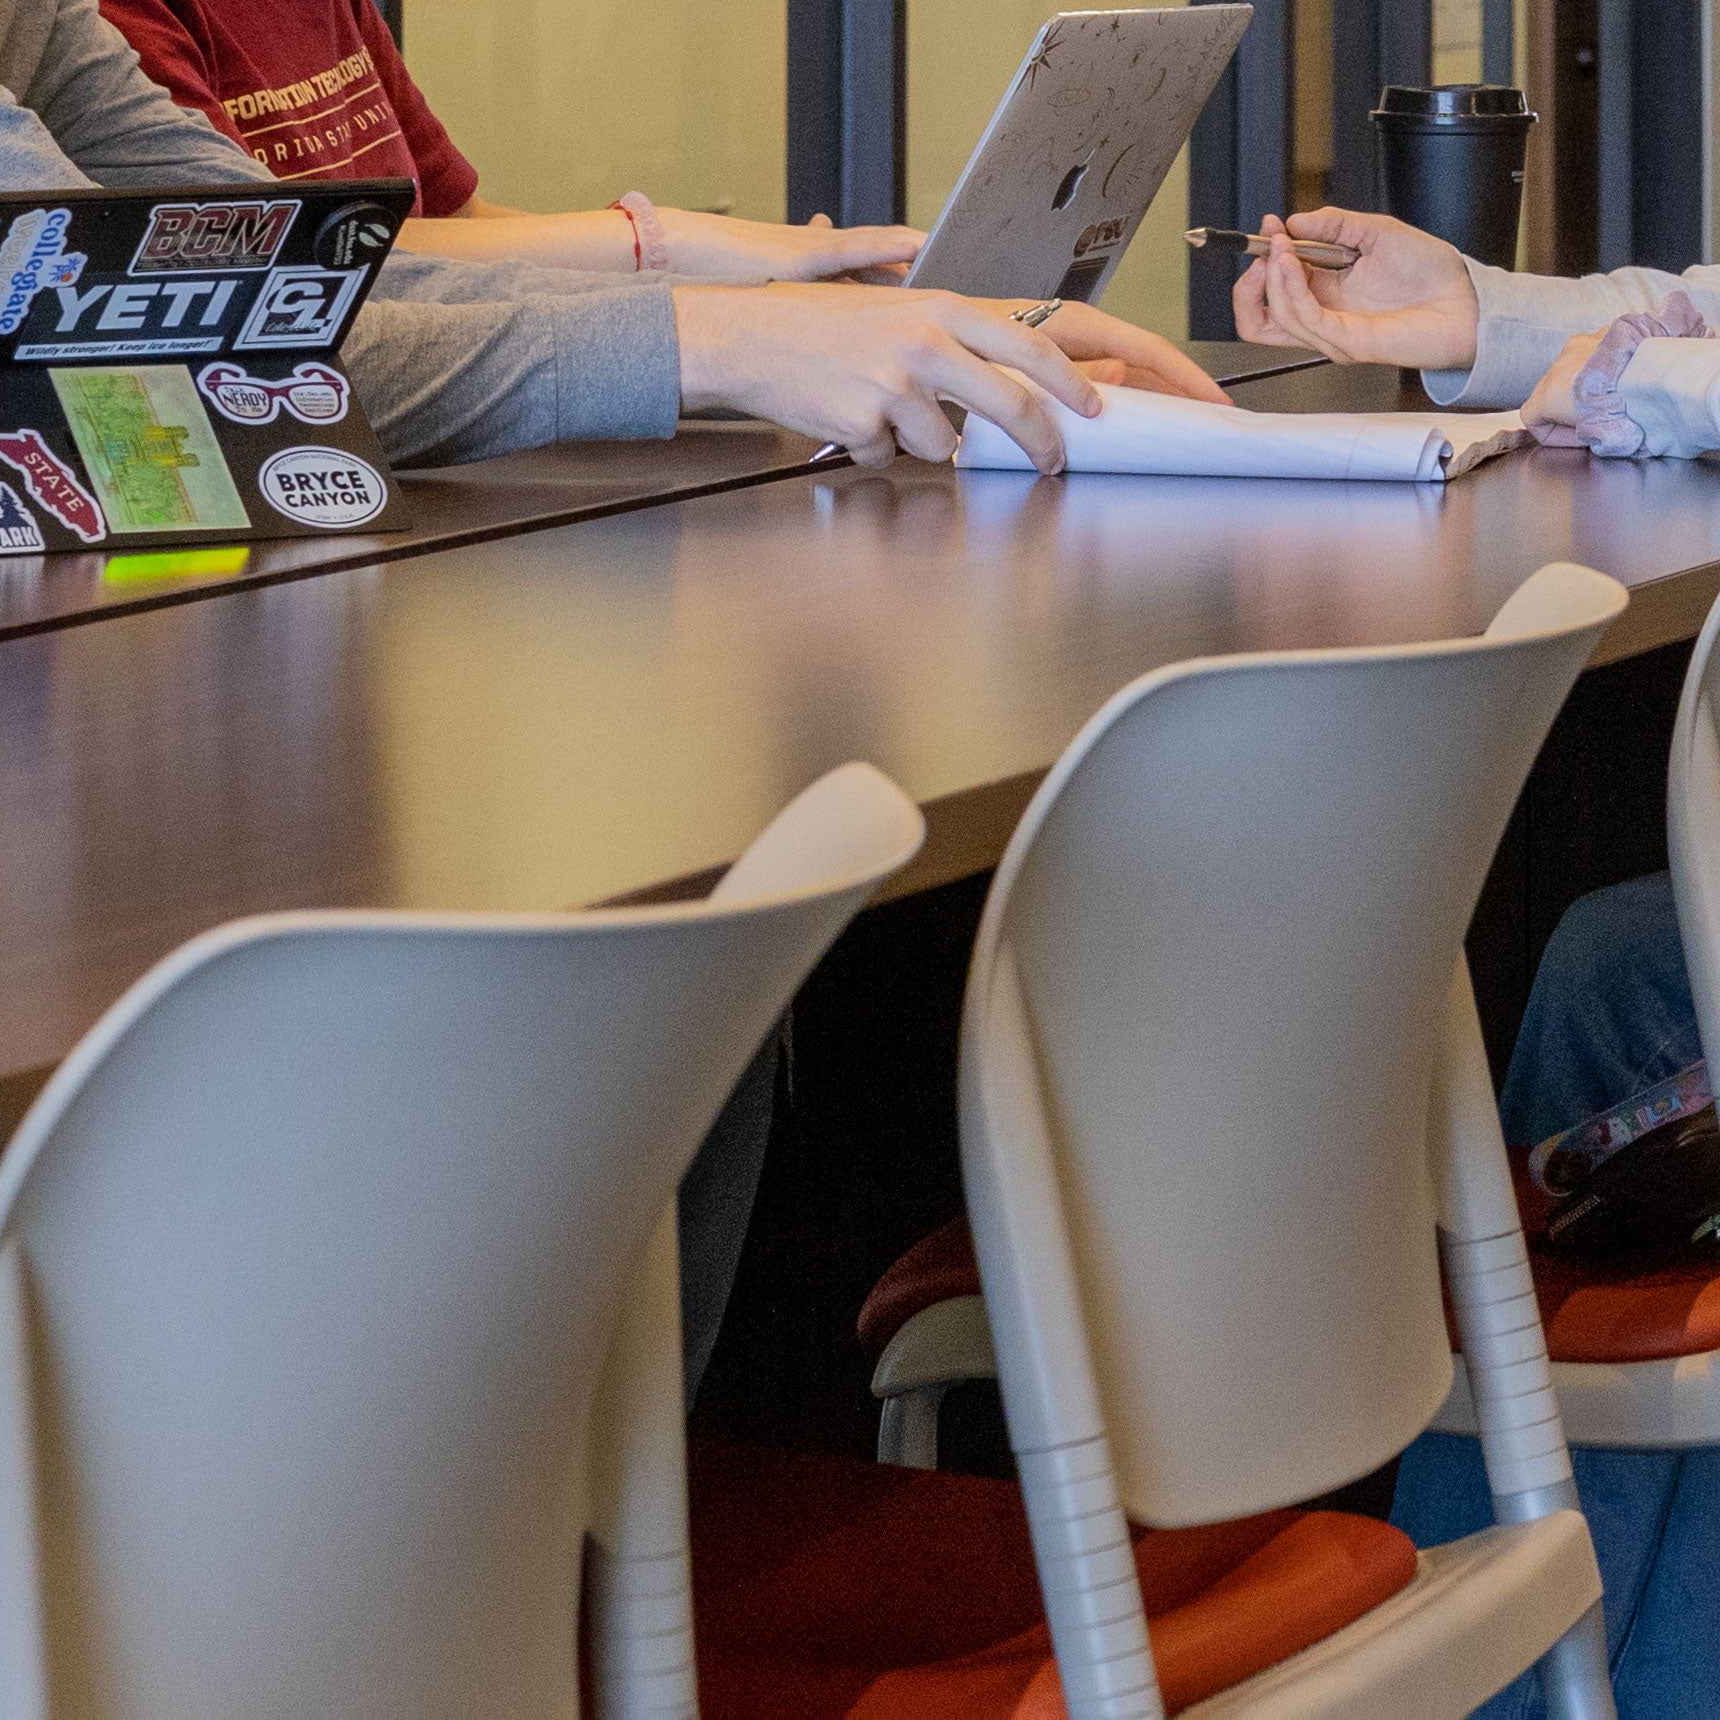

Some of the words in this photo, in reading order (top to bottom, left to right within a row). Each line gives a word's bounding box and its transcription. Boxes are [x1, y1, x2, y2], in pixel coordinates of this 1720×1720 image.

[143, 205, 296, 259] BCM
[54, 279, 239, 333] YETI
[25, 345, 61, 357] Wildly
[62, 343, 116, 355] stronger!
[117, 342, 146, 353] Keep
[148, 341, 166, 350] ice
[167, 338, 211, 352] longer!
[222, 392, 268, 407] NERDY
[24, 451, 84, 512] STATE
[276, 470, 366, 492] BRYCE
[284, 490, 372, 508] CANYON
